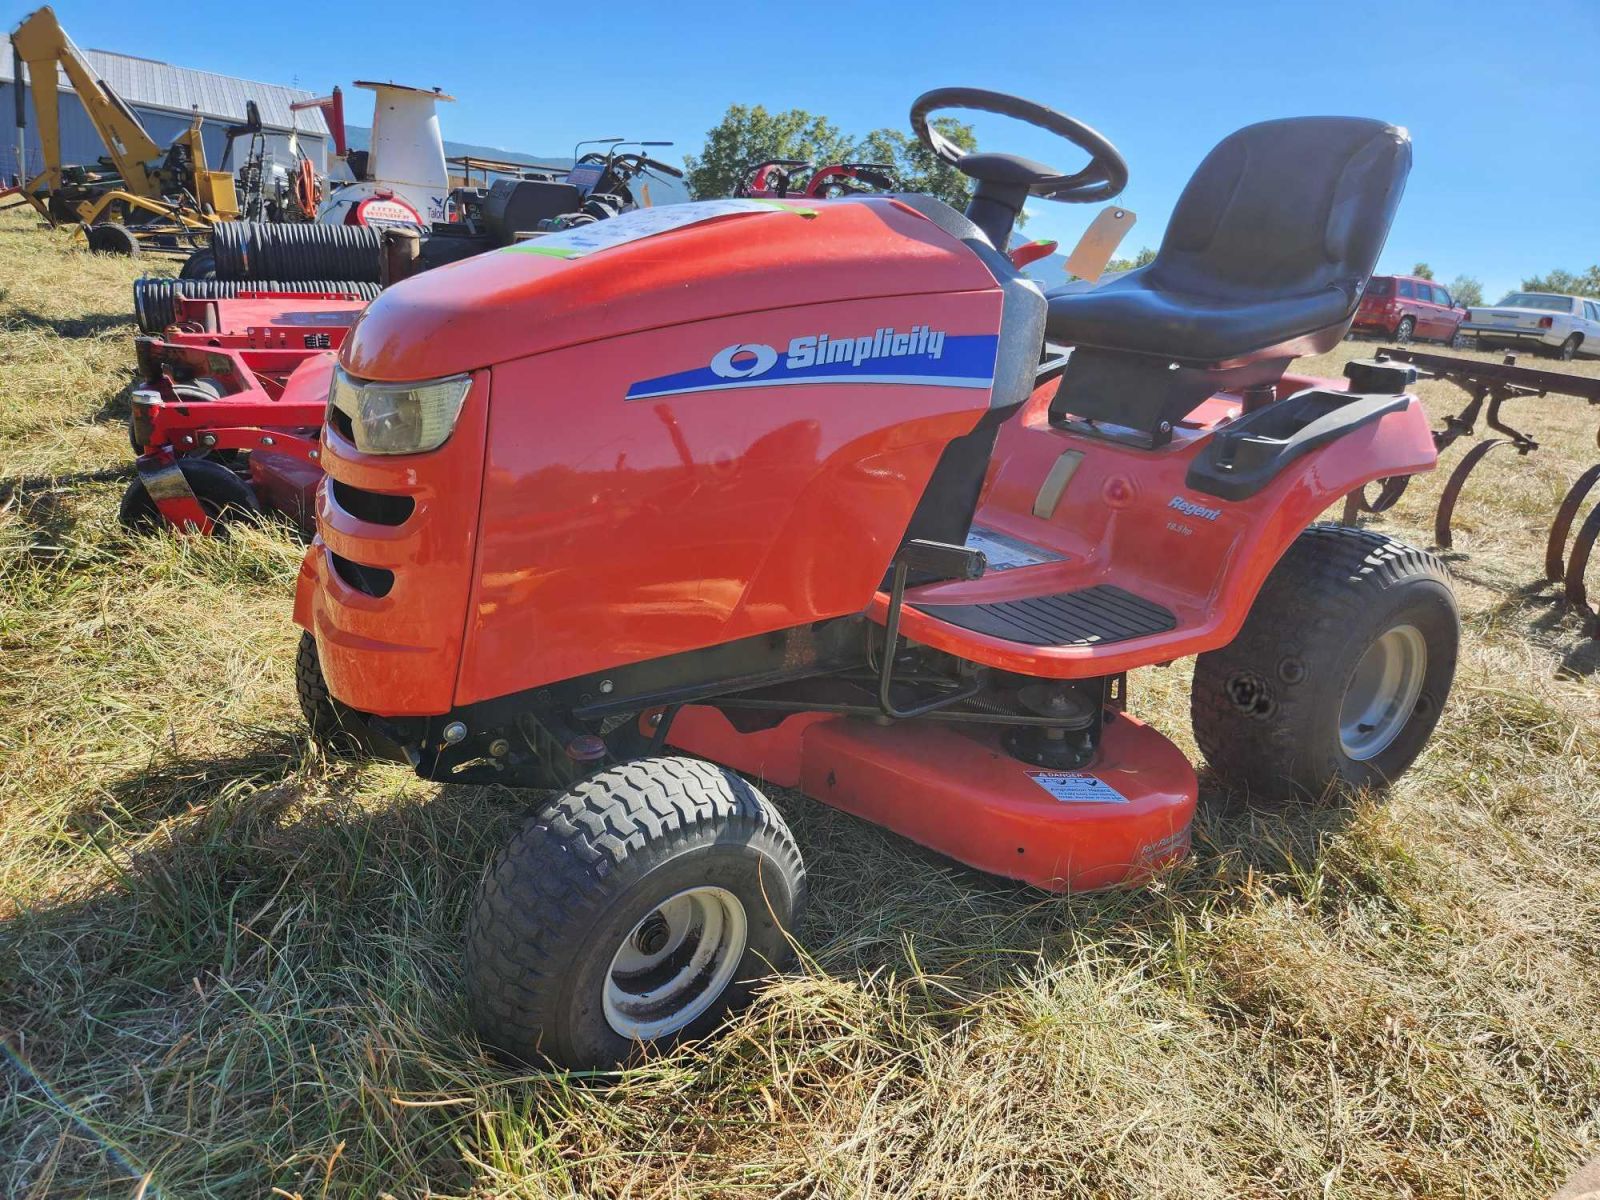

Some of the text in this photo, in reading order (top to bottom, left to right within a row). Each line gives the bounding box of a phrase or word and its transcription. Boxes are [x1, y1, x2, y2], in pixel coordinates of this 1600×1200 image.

[366, 211, 410, 219] WONDER
[372, 206, 405, 214] LITTLE
[786, 325, 946, 370] Simplicity
[1168, 495, 1221, 521] Regent
